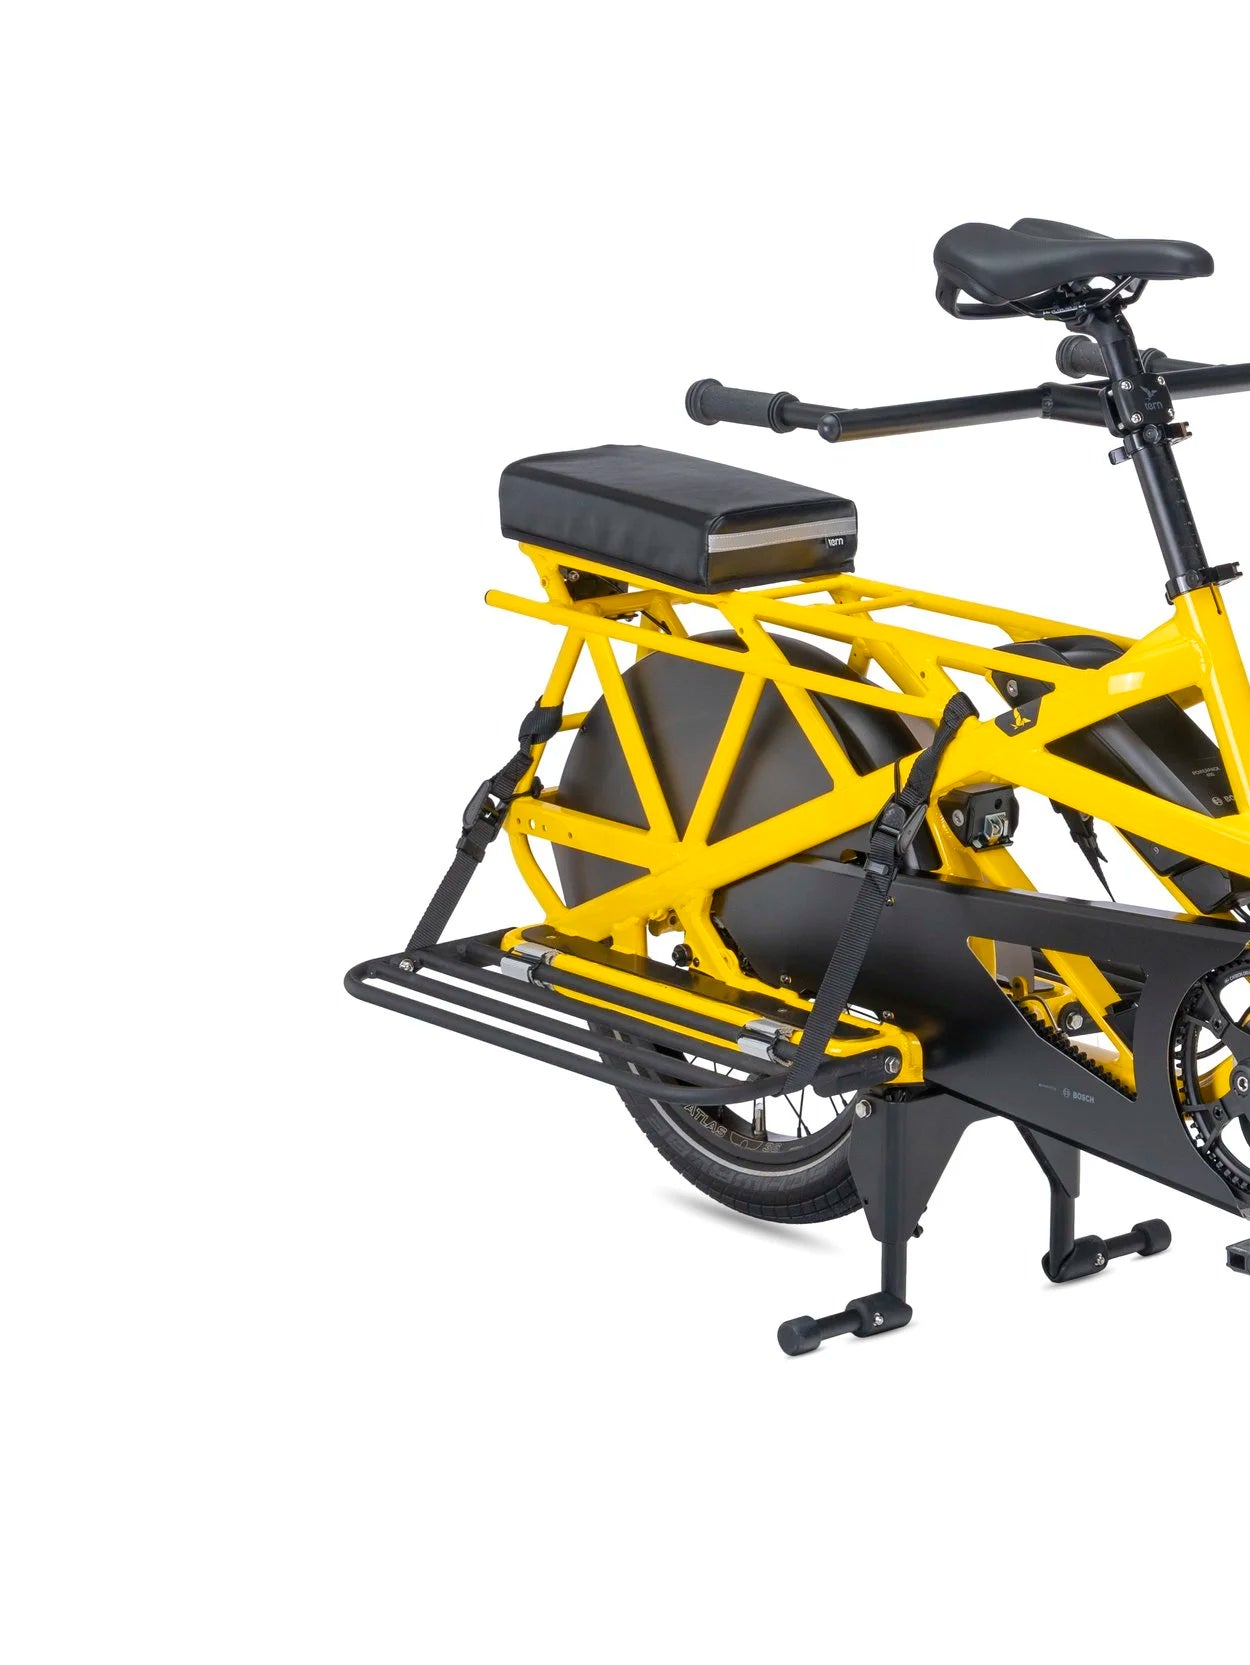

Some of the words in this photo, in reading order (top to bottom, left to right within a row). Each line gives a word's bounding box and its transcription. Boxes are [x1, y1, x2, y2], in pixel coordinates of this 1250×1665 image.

[1144, 401, 1163, 410] tern
[828, 537, 844, 546] tern
[1072, 1091, 1095, 1104] BOSCH
[683, 1103, 728, 1138] ATLAS
